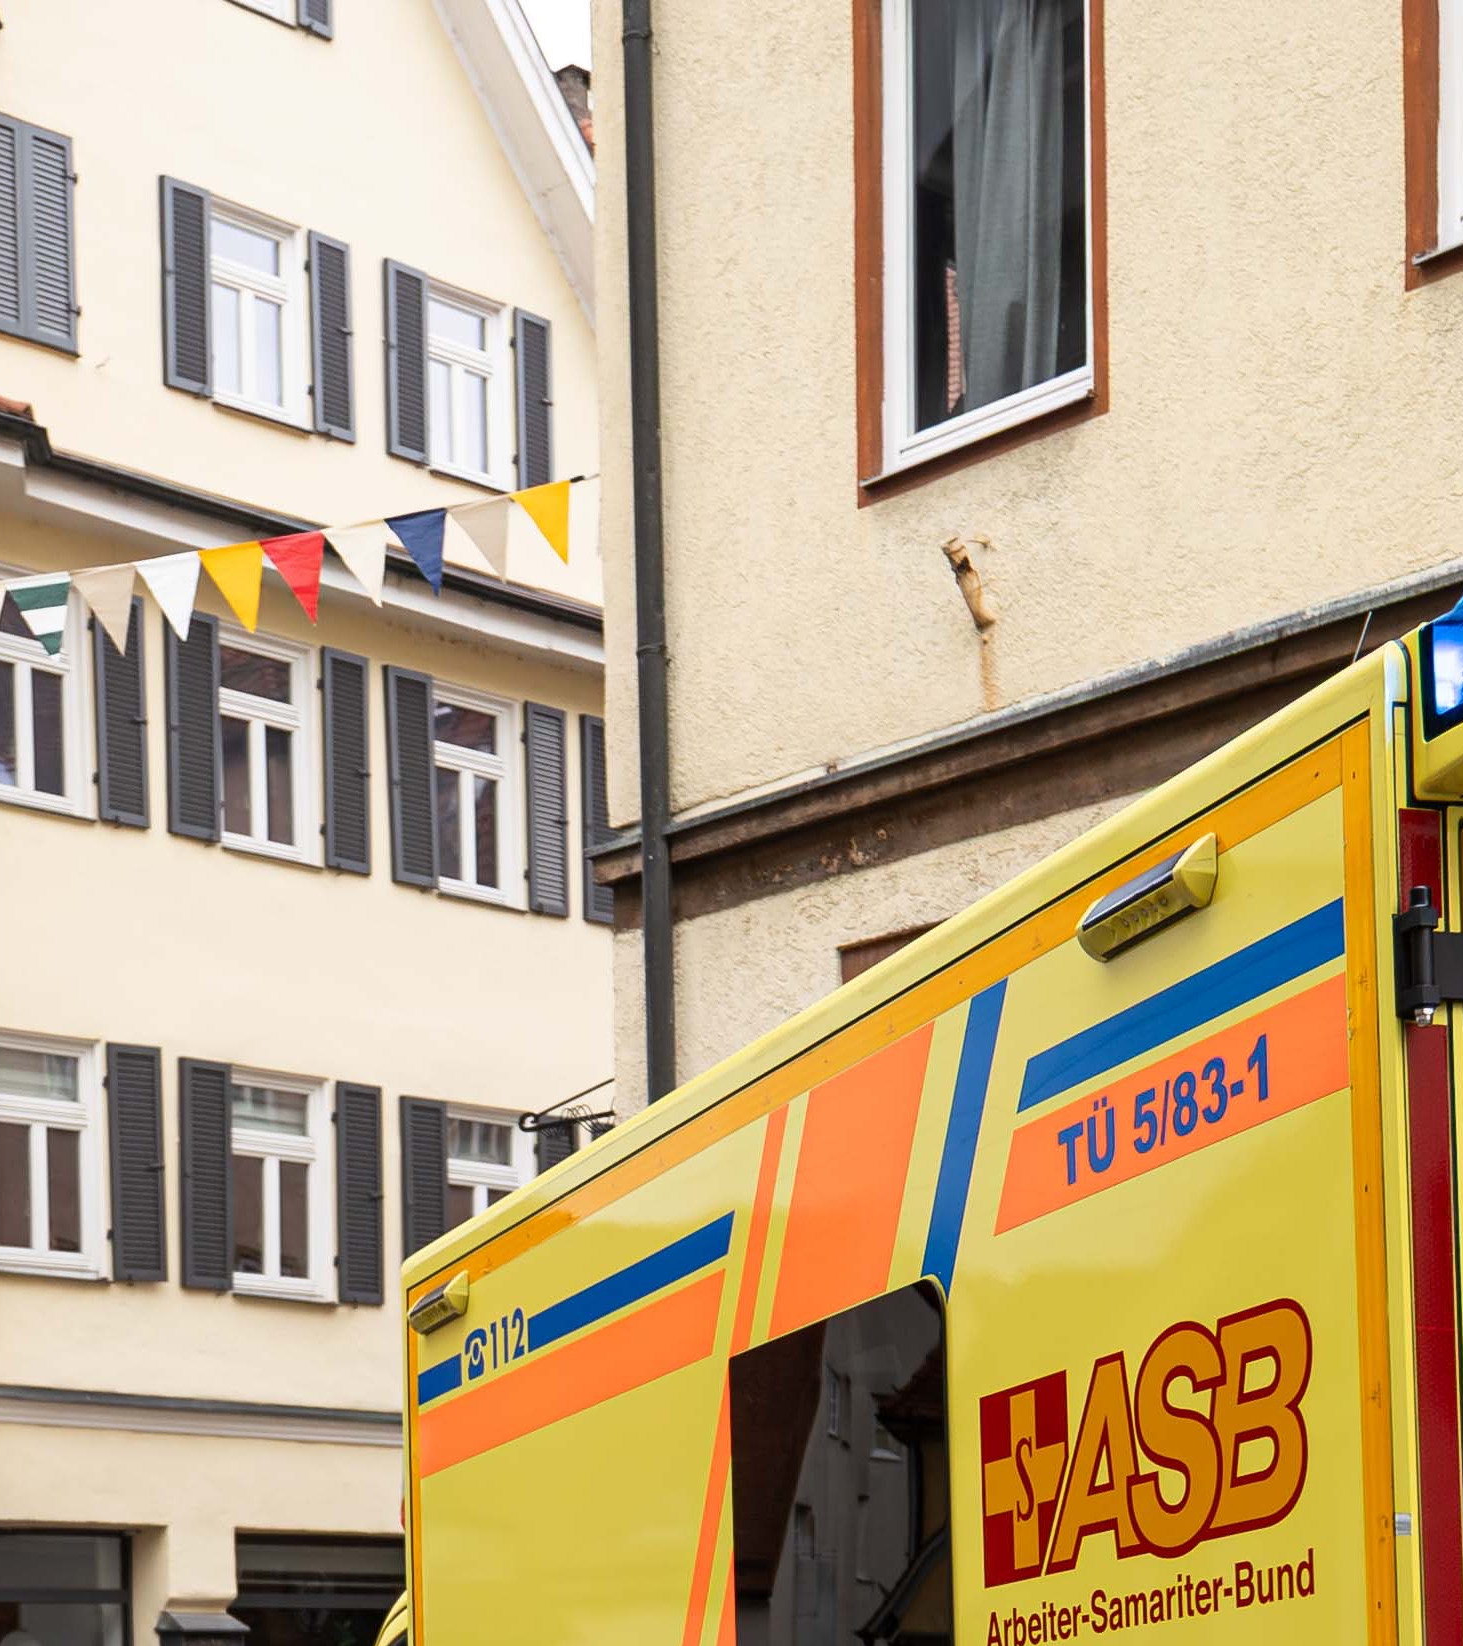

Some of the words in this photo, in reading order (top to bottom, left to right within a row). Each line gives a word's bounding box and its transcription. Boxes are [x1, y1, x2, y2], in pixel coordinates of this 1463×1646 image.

[1057, 1096, 1116, 1185] TÜ
[1134, 1033, 1269, 1154] 5/83-1
[490, 1307, 525, 1370] 112
[1045, 1297, 1313, 1576] ASB
